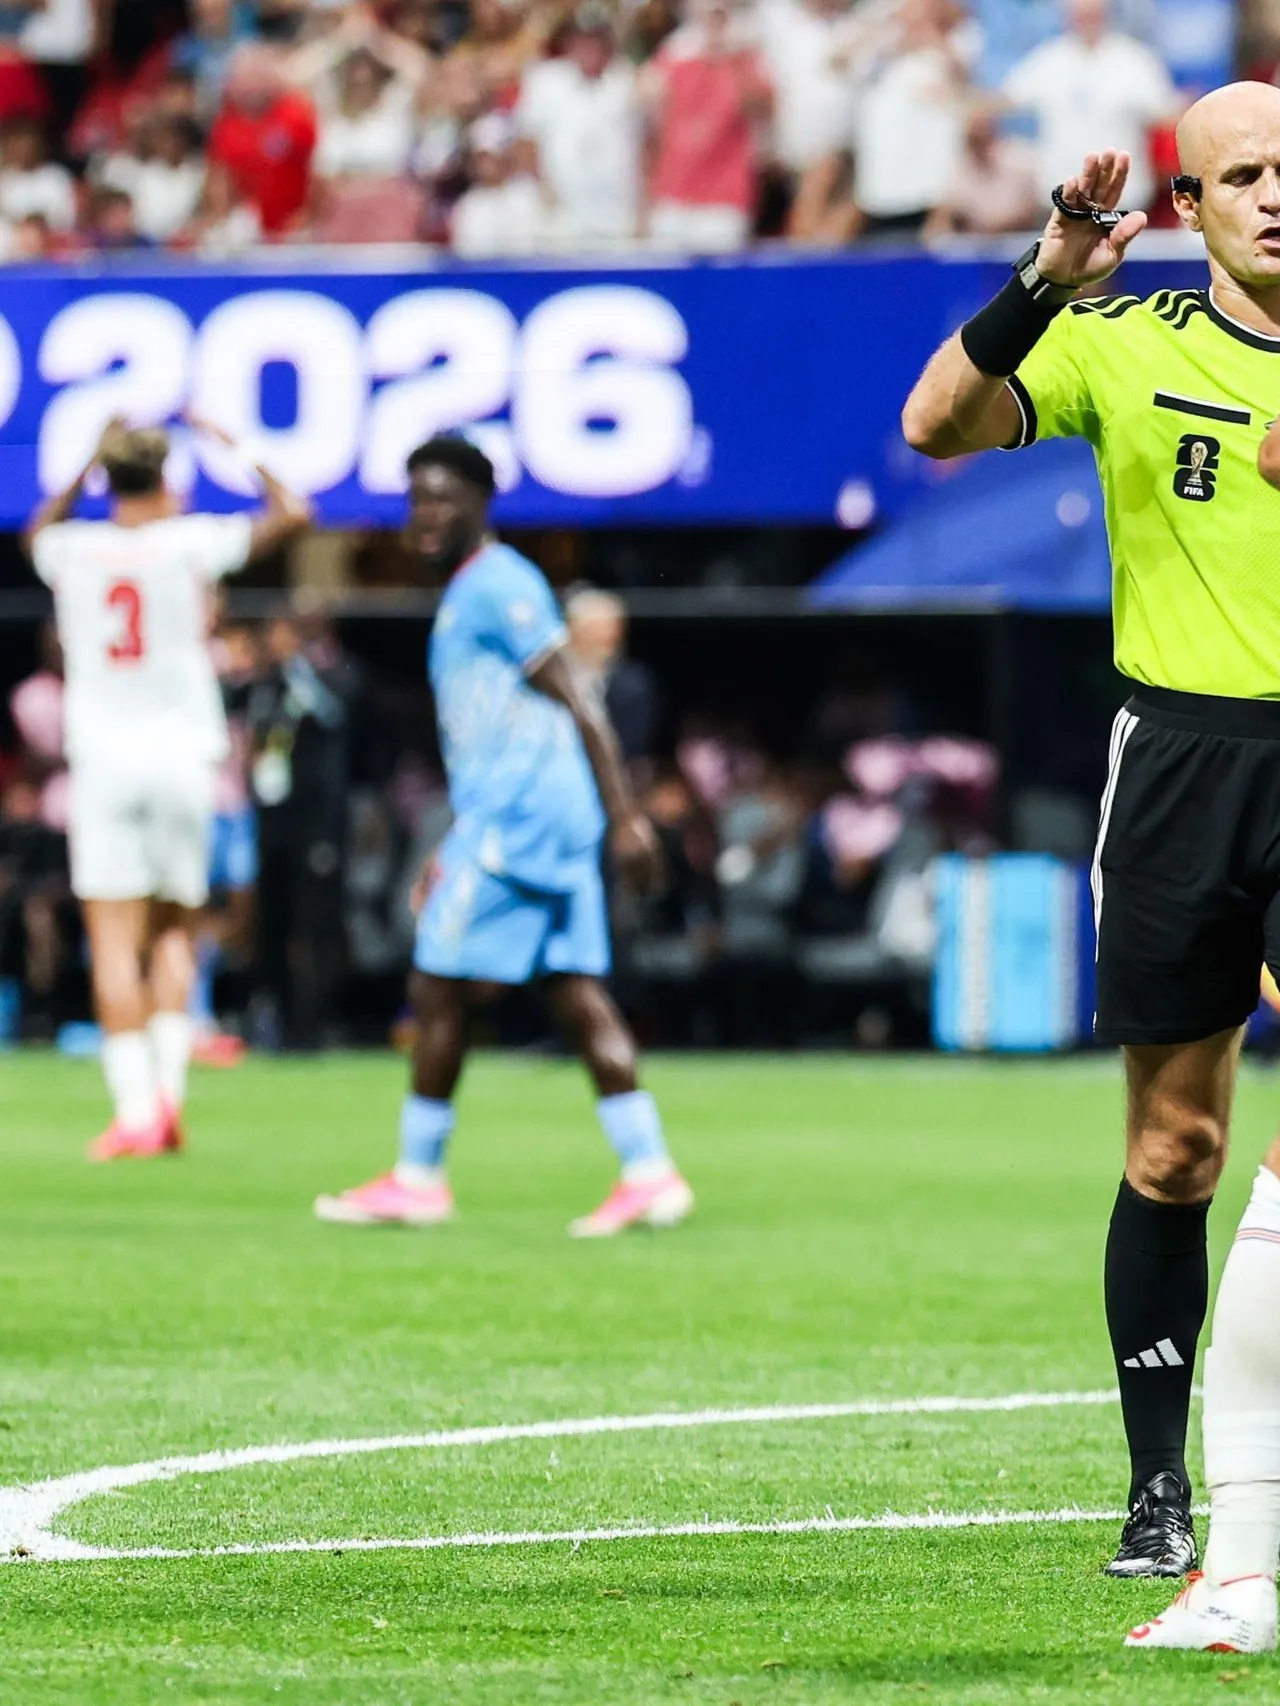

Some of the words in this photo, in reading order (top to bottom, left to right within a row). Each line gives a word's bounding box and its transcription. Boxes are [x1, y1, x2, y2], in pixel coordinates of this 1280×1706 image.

[37, 285, 692, 498] 2026
[1183, 486, 1204, 497] FIFA
[106, 577, 146, 667] 3
